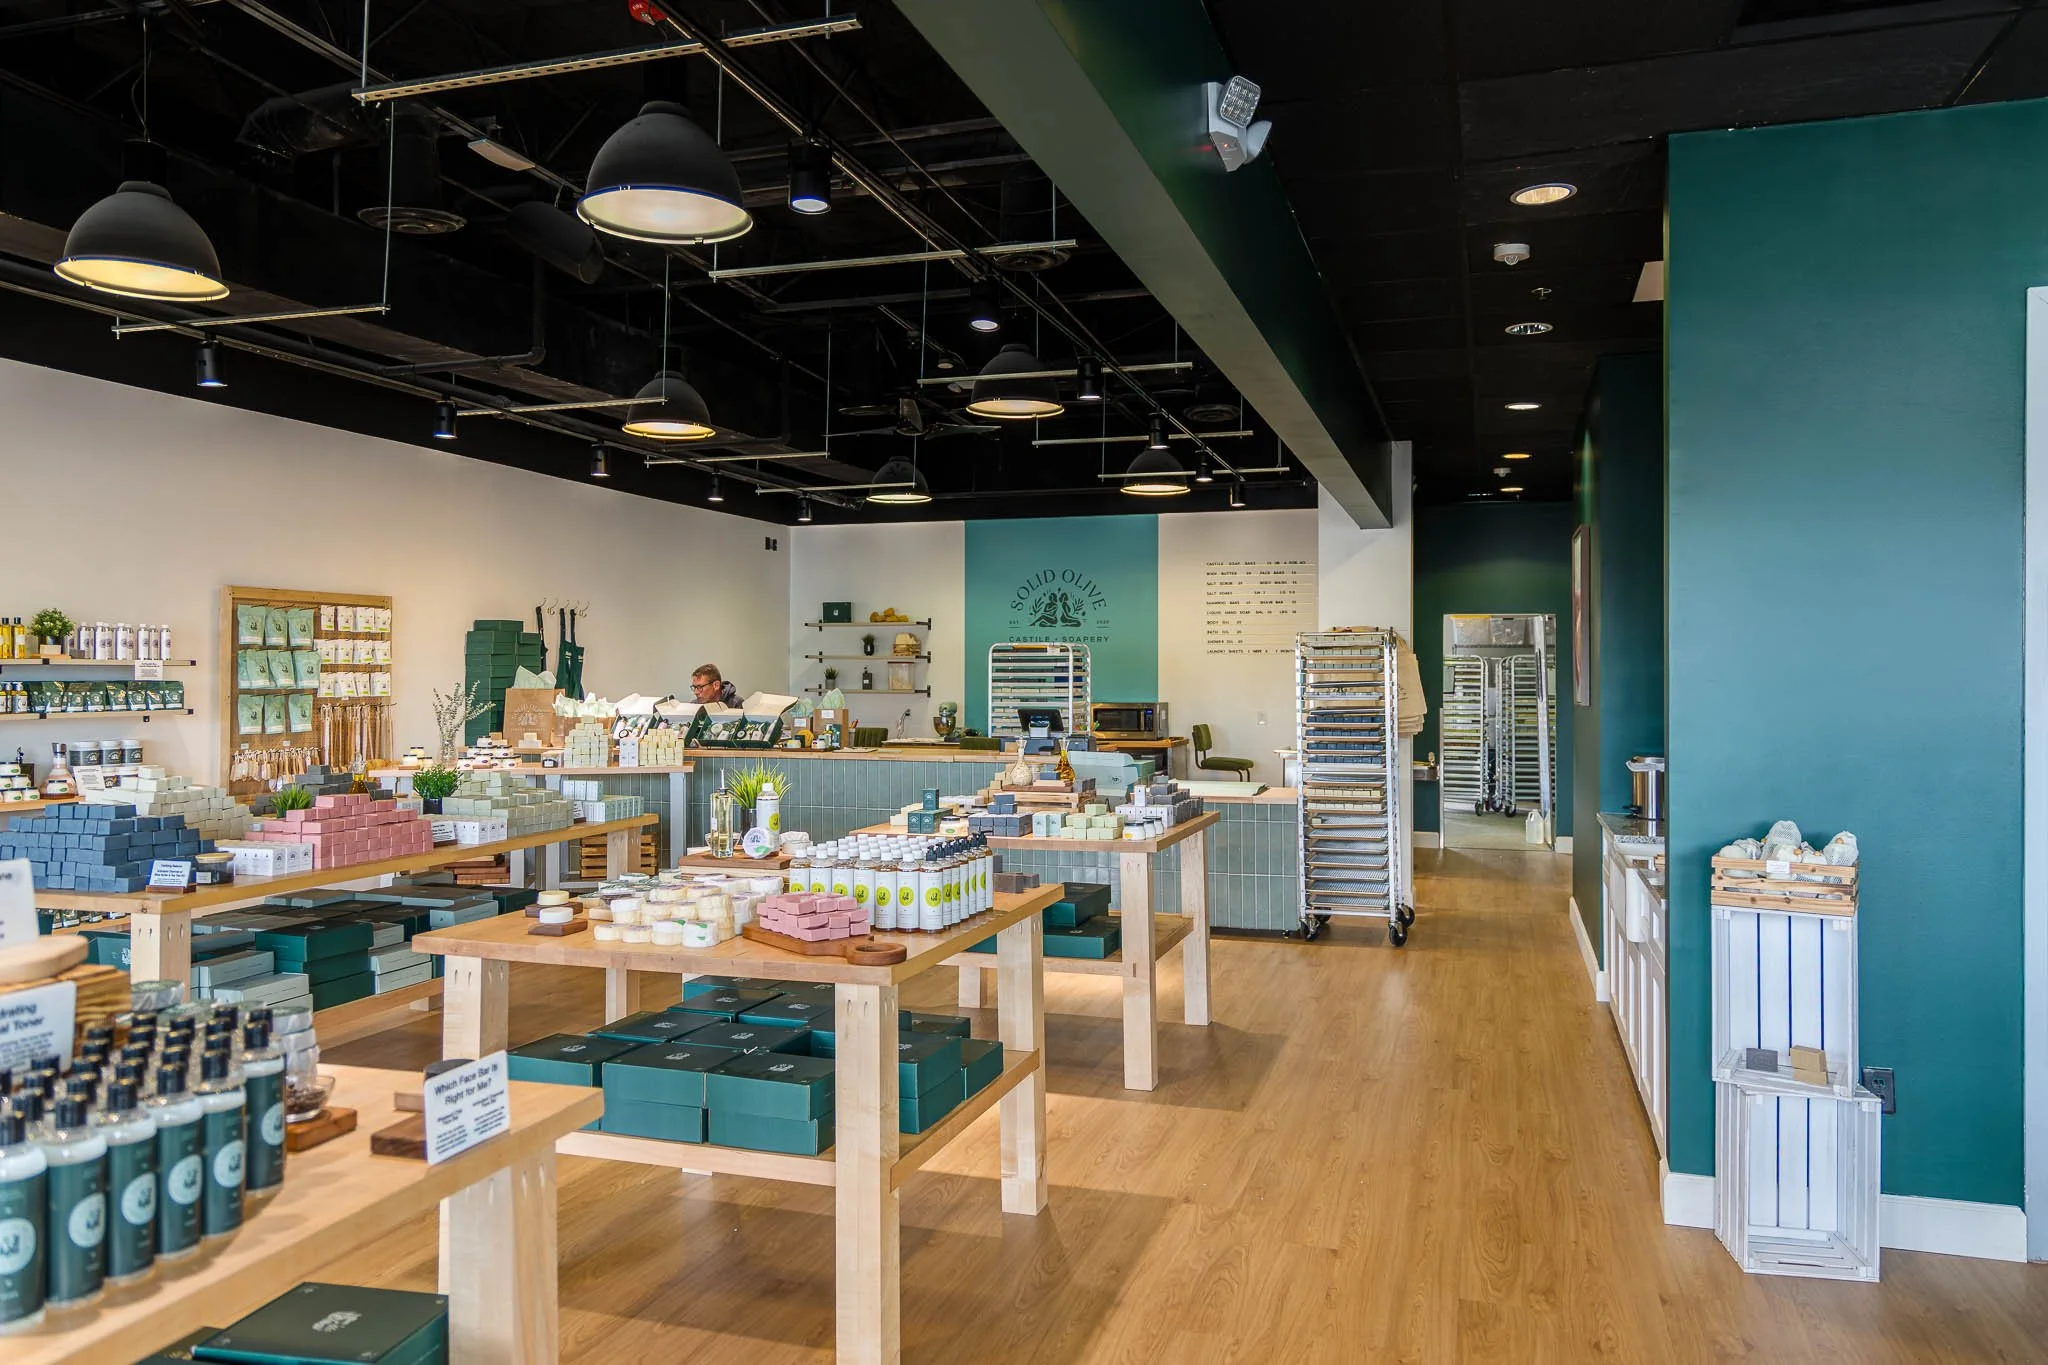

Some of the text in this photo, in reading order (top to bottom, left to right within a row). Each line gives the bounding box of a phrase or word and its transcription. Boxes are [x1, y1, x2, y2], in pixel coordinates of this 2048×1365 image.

[1010, 568, 1107, 611] SOLID OLIVE
[434, 1080, 458, 1096] Which
[460, 1074, 476, 1084] Face
[478, 1067, 490, 1077] Bar
[444, 1078, 492, 1105] Right for Me?
